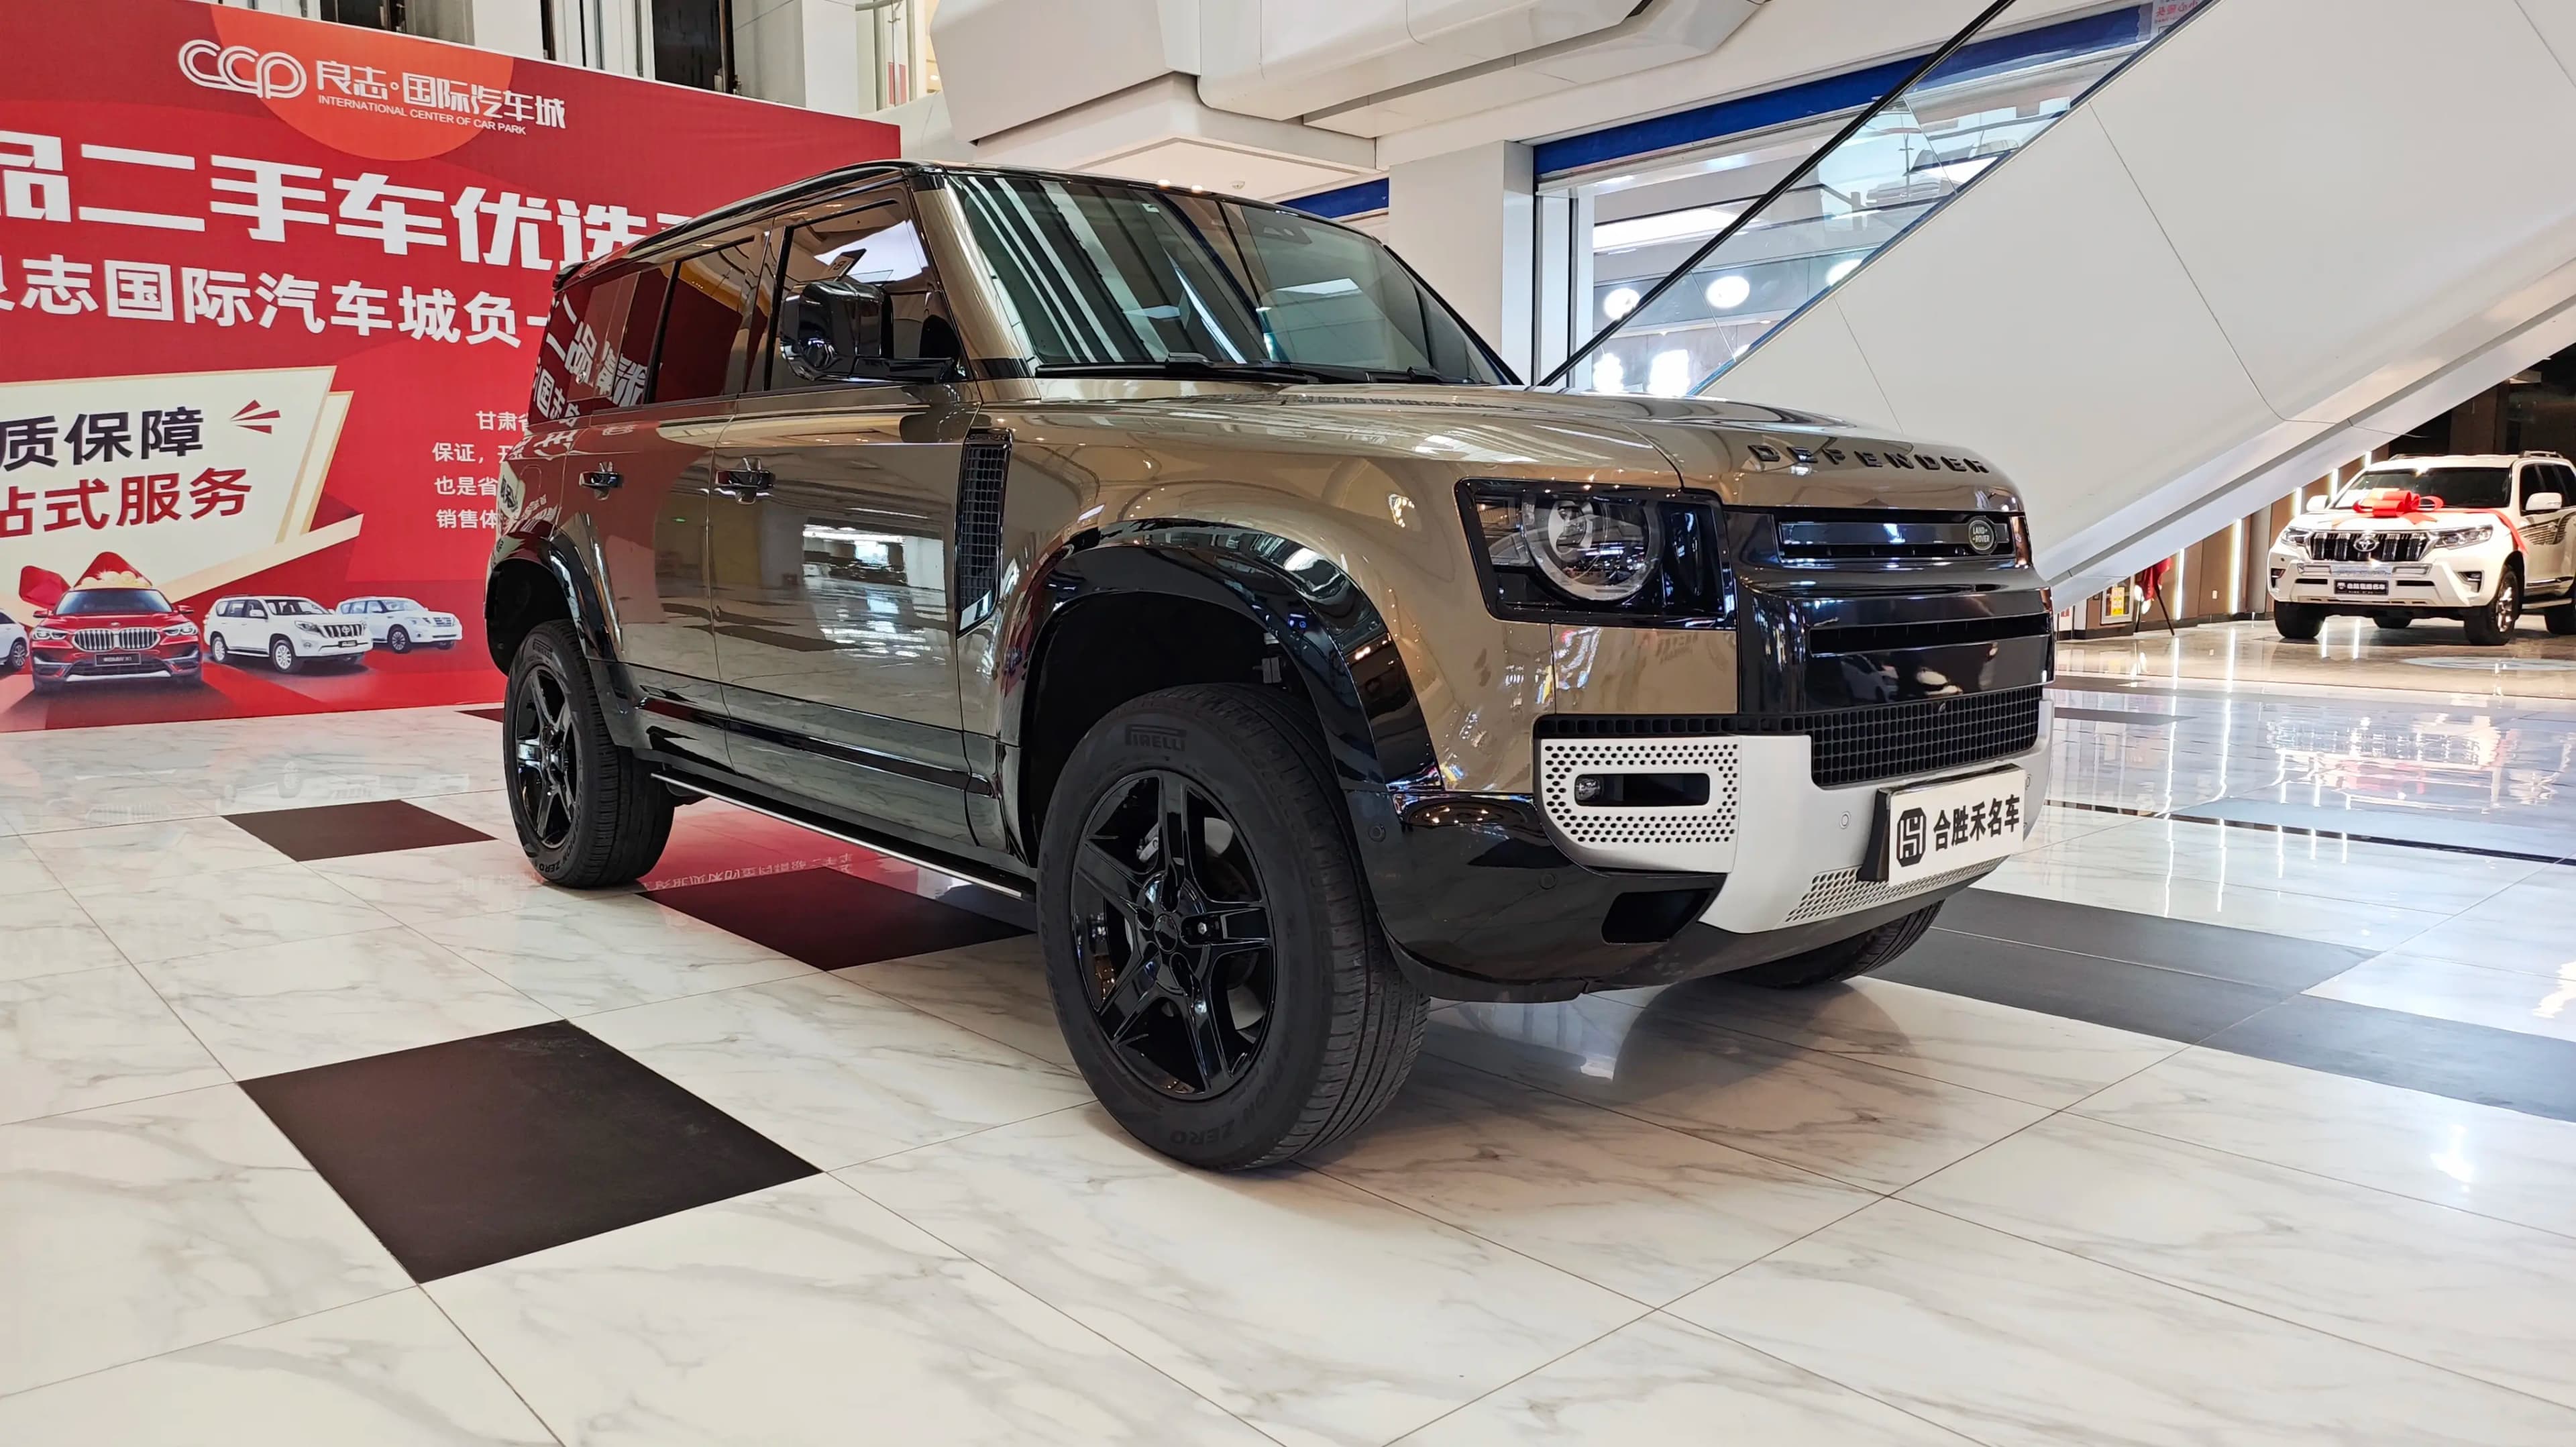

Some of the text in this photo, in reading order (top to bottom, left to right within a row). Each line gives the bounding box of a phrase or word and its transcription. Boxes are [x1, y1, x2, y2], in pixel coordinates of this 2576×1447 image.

[319, 95, 527, 136] INTERNATIONAL CENTER OF CAR PARK
[0, 254, 547, 347] 志国际汽车城负
[0, 406, 204, 472] 质保障
[1748, 444, 1990, 474] DEFENDER
[435, 476, 498, 496] 也是省
[436, 509, 498, 529] 销售体
[1125, 724, 1187, 752] PIRELLI
[1933, 794, 2021, 852] 合胜禾名车
